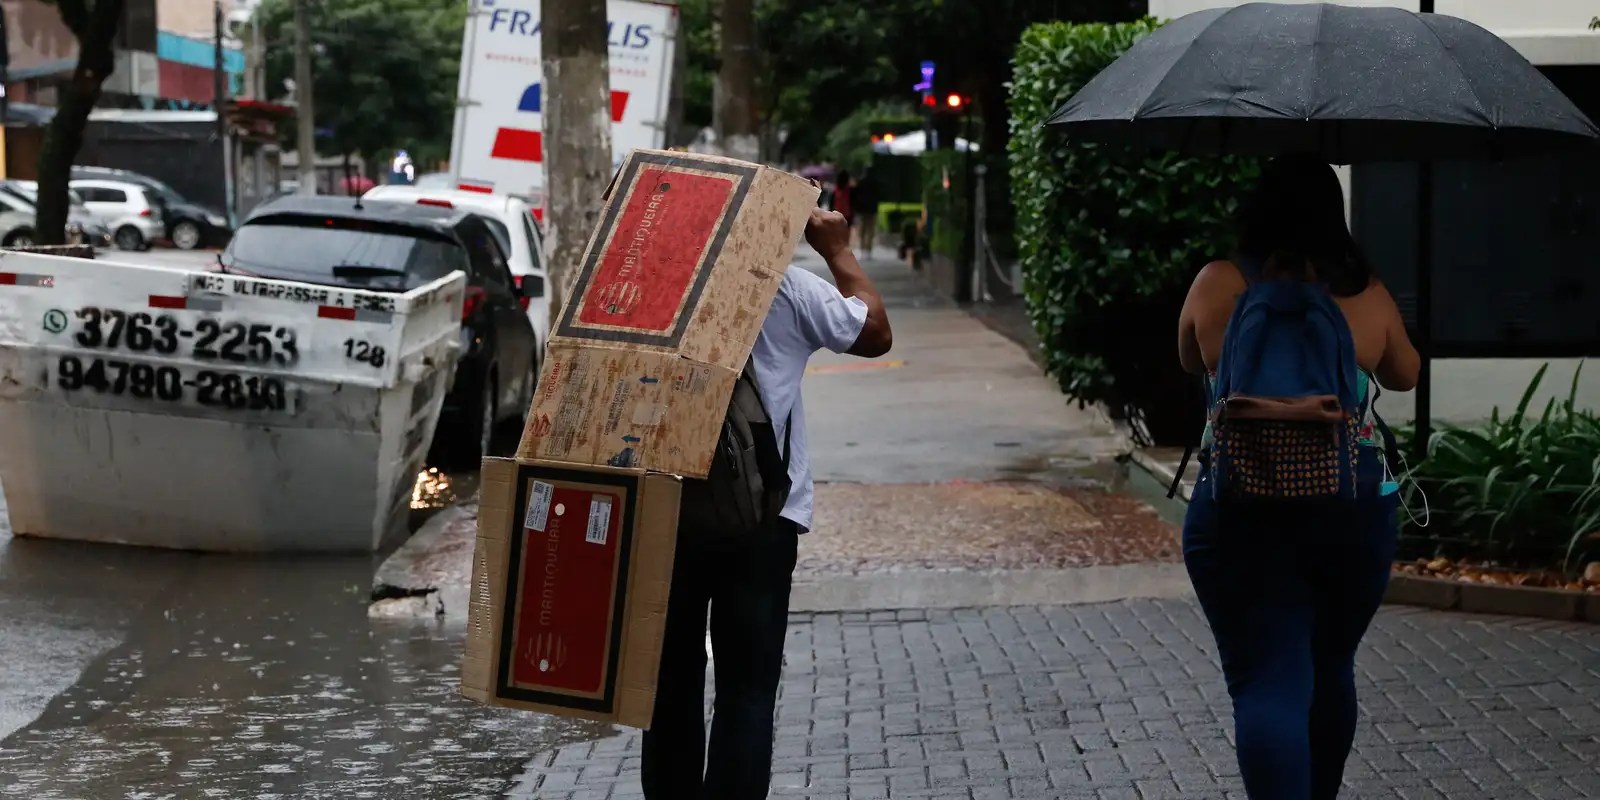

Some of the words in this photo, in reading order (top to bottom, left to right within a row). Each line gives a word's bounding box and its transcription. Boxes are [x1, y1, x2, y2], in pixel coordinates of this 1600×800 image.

[75, 306, 299, 368] 3763-2253
[343, 337, 386, 368] 128
[539, 518, 561, 626] MANTIQUEIRA
